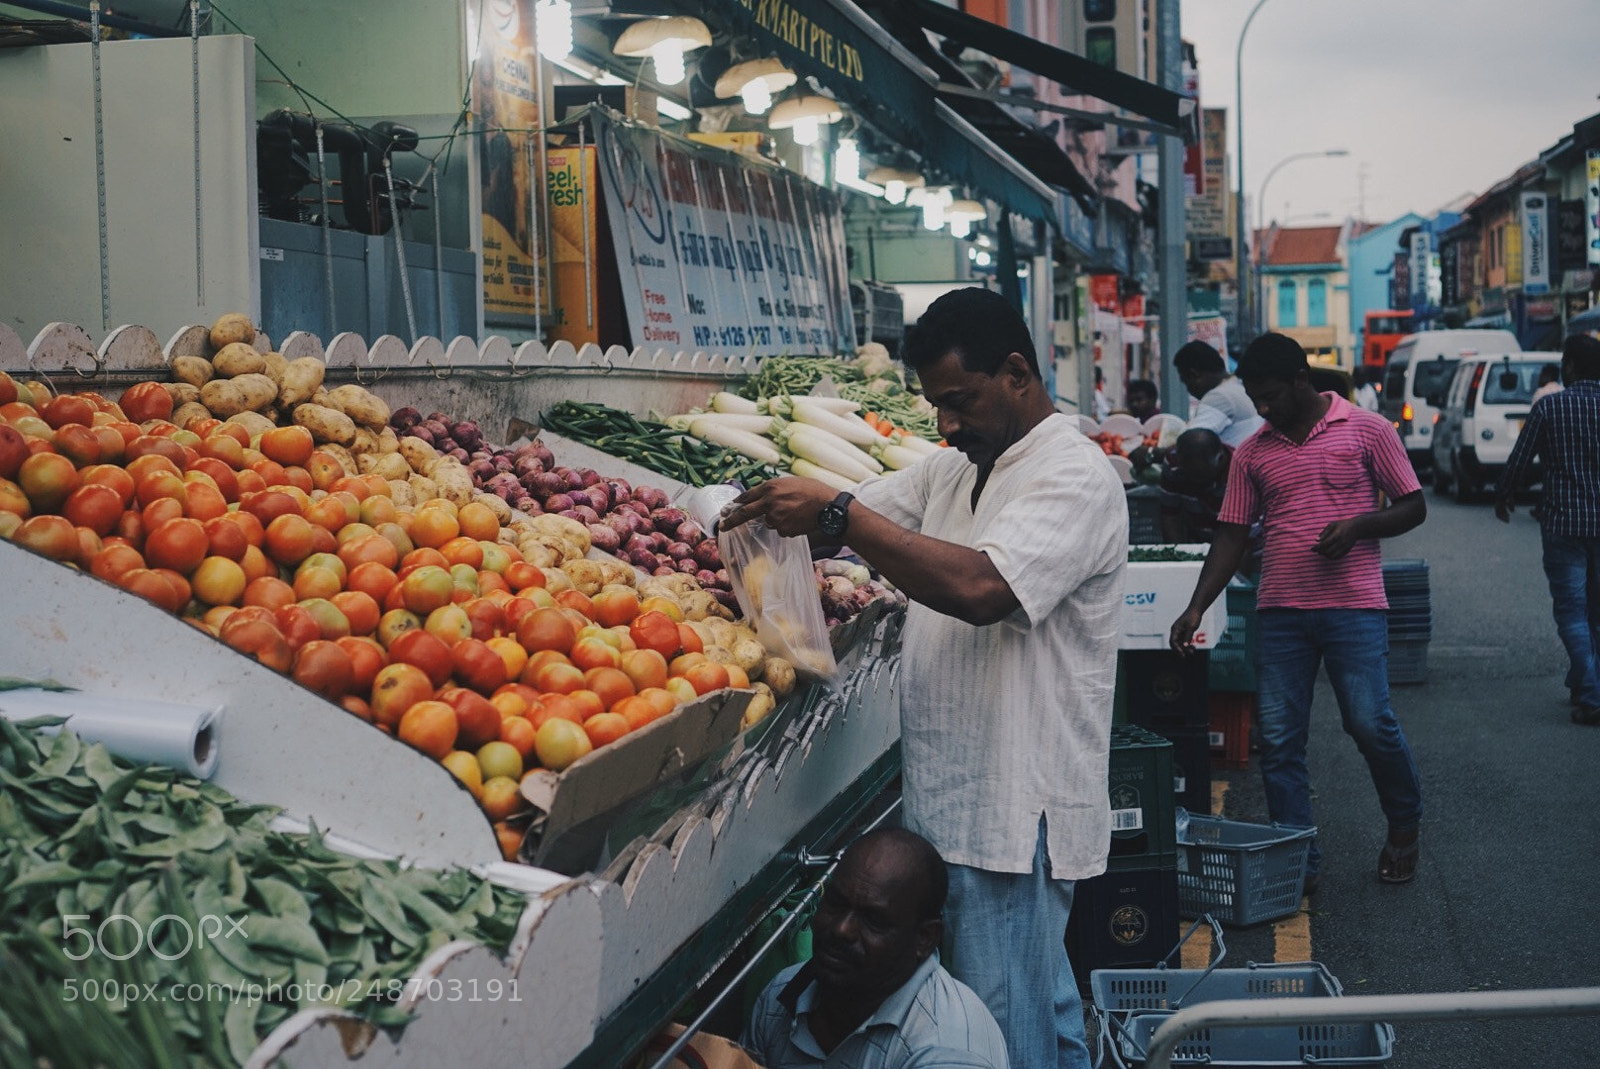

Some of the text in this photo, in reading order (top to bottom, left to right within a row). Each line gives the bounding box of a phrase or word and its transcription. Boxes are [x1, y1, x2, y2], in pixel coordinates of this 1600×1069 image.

[810, 22, 835, 69] PTE
[837, 39, 863, 82] LTD
[547, 164, 572, 188] eel
[548, 183, 584, 206] resh
[644, 289, 665, 305] Free
[645, 308, 673, 323] Home
[644, 326, 680, 345] Delivery
